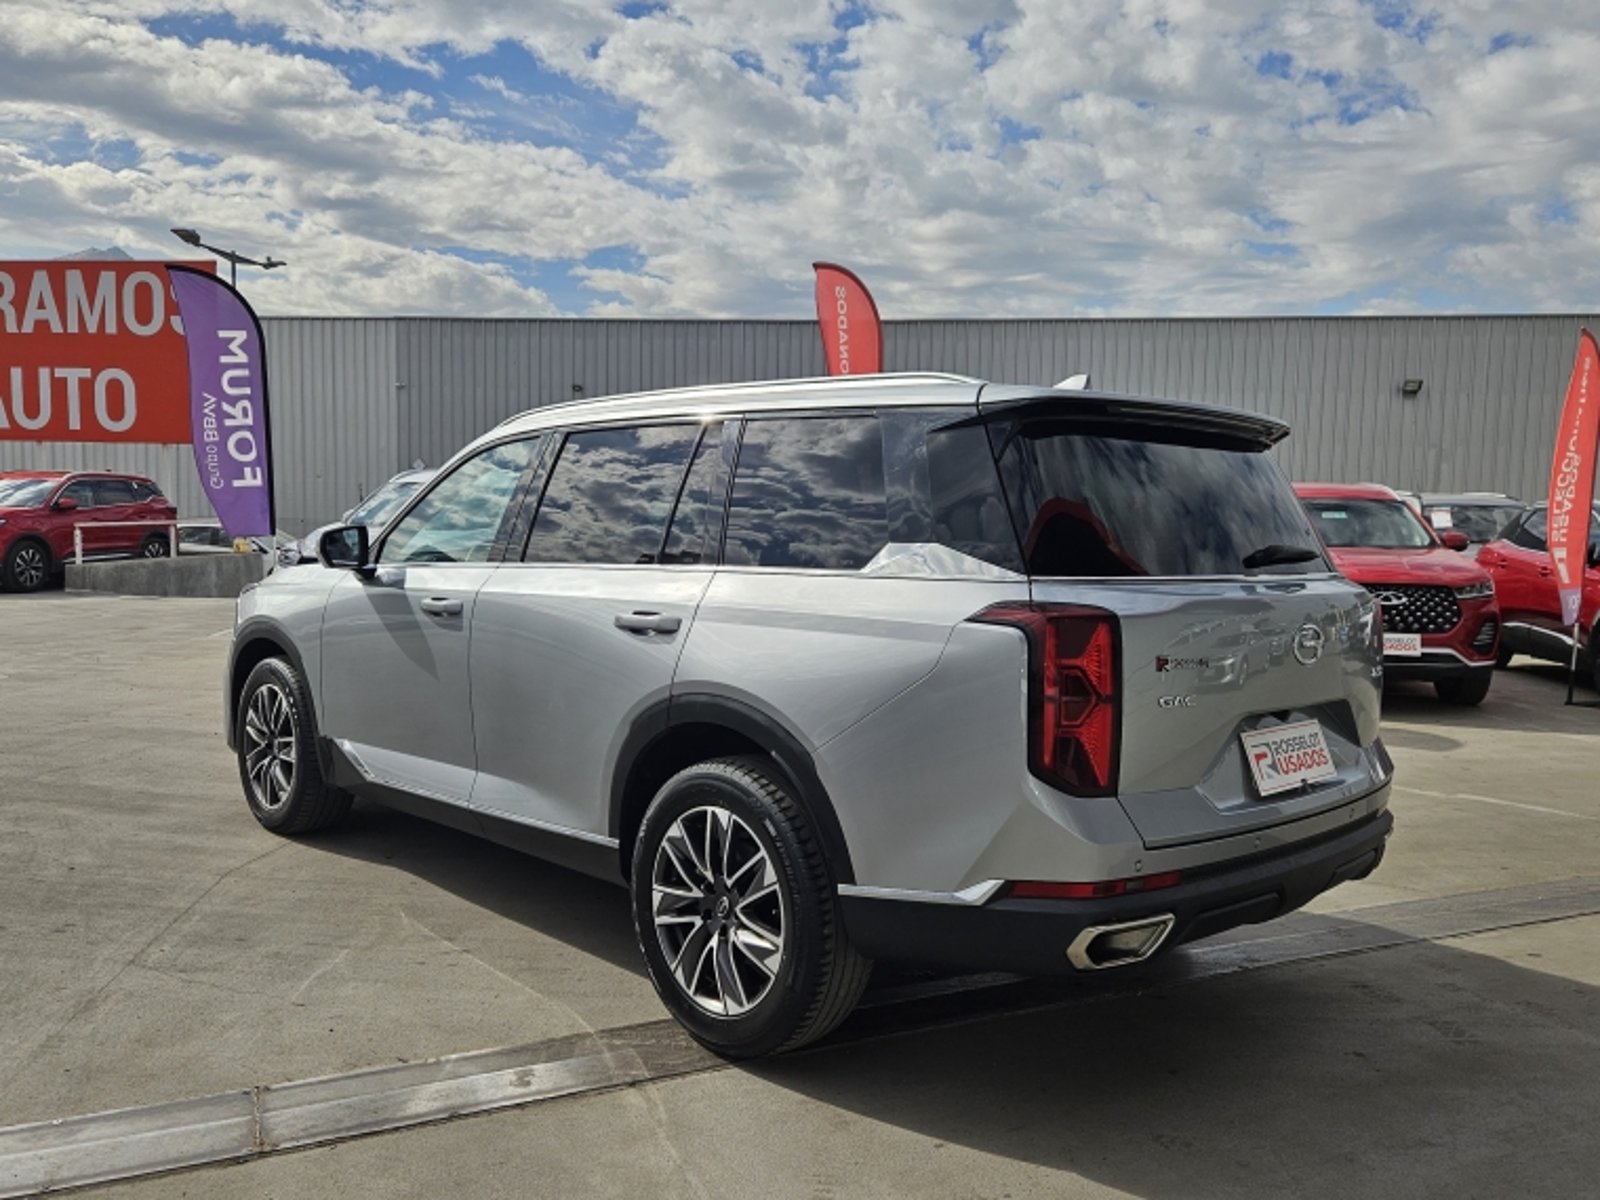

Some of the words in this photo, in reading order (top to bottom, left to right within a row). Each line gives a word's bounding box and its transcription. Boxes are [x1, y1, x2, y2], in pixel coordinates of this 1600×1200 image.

[0, 269, 186, 336] RAMO
[0, 366, 137, 432] UTO
[1271, 732, 1320, 756] ROSSELOT
[1276, 748, 1329, 775] USADOS
